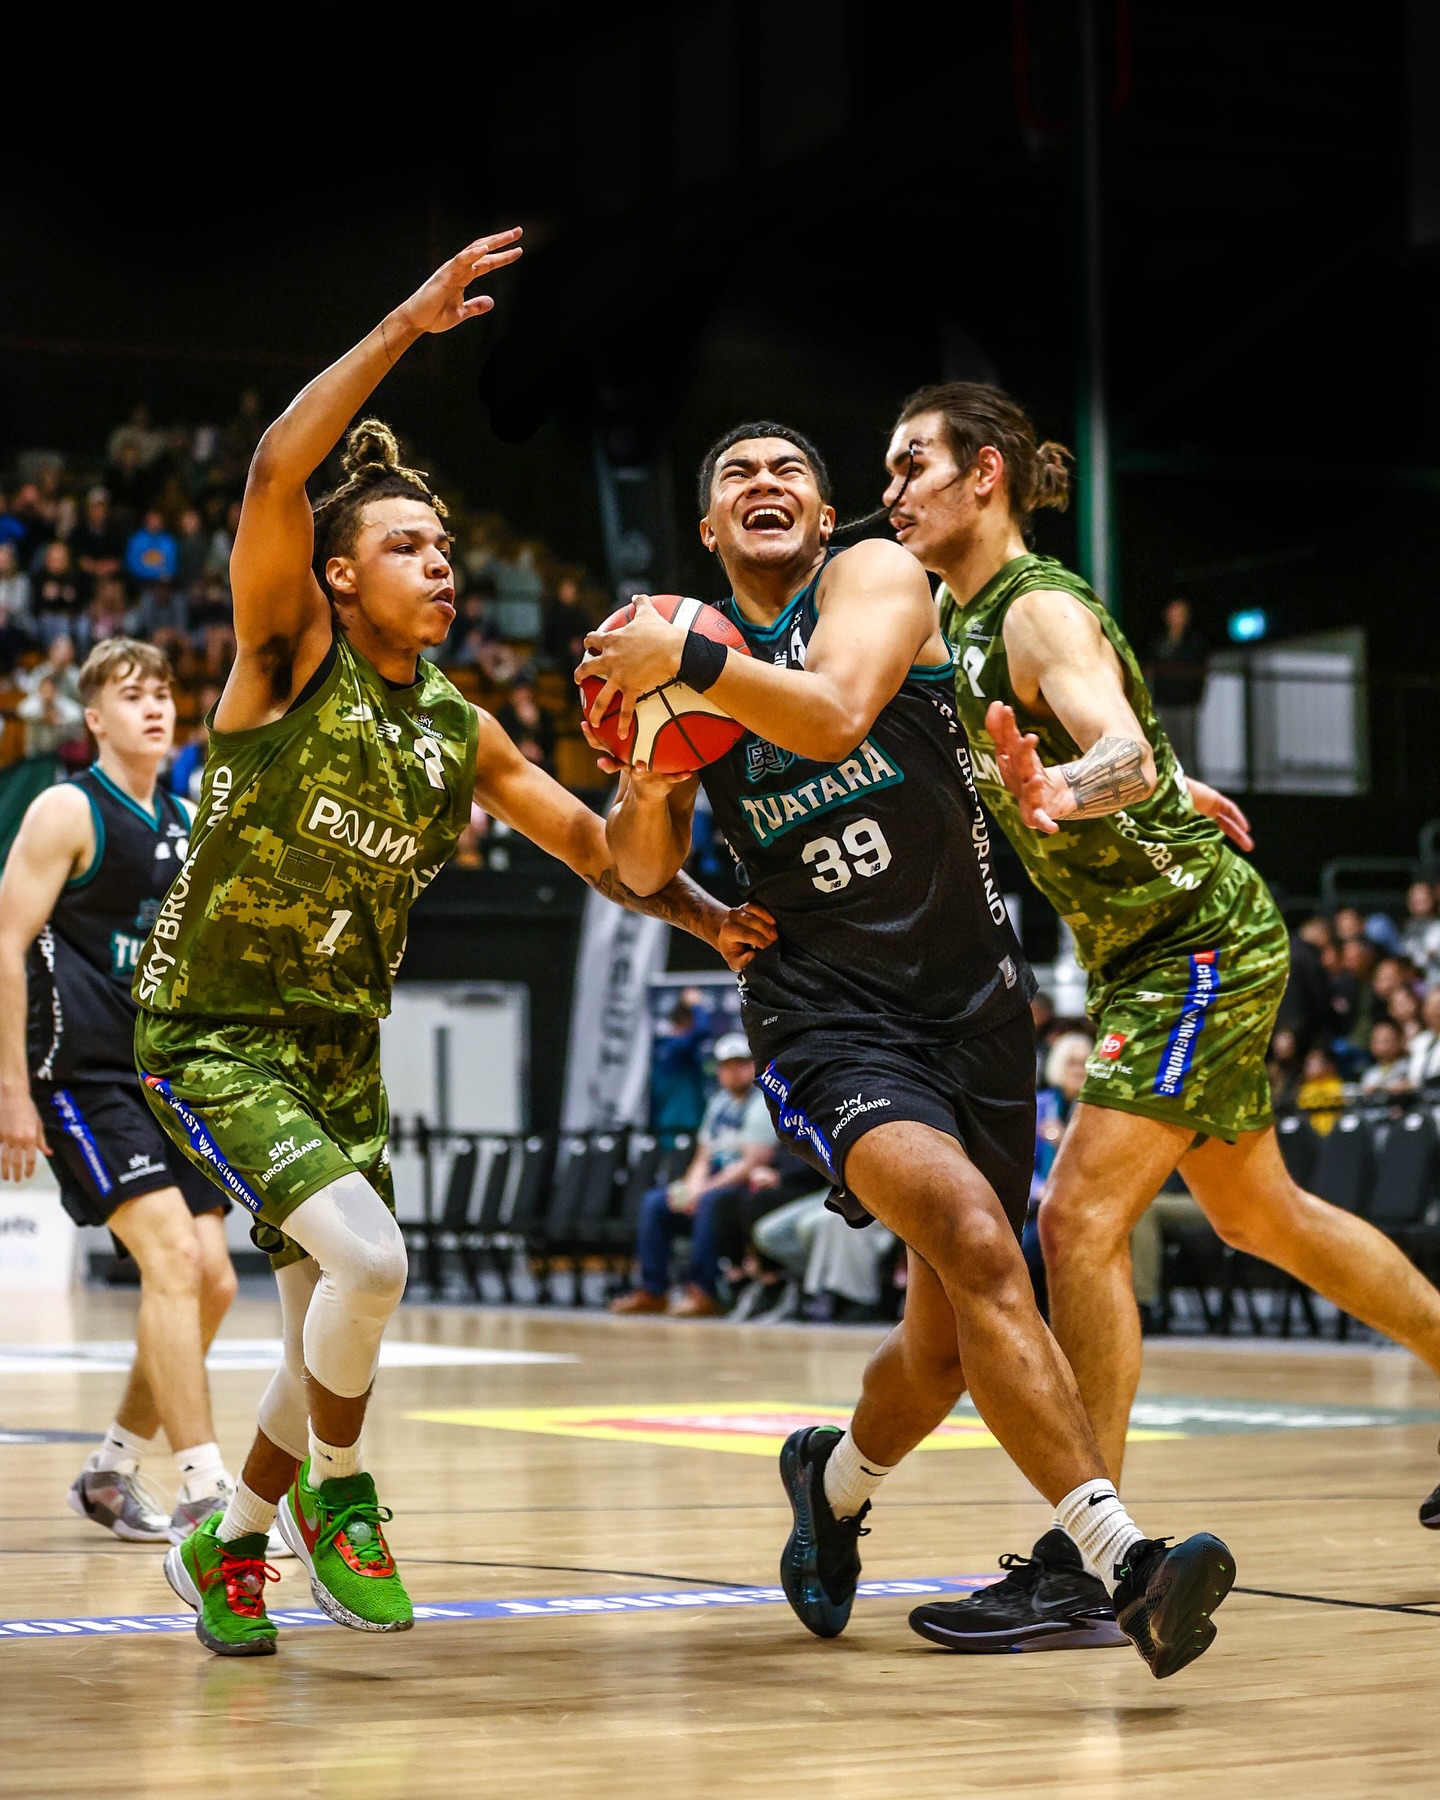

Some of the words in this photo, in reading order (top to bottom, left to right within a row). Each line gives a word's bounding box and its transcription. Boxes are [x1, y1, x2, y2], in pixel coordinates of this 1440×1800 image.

[742, 739, 897, 840] TUATARA
[154, 765, 234, 943] BROAAND
[801, 817, 892, 893] 39
[315, 910, 353, 956] 1
[831, 1098, 891, 1139] BROADBAND
[261, 1138, 322, 1183] BROADBAND
